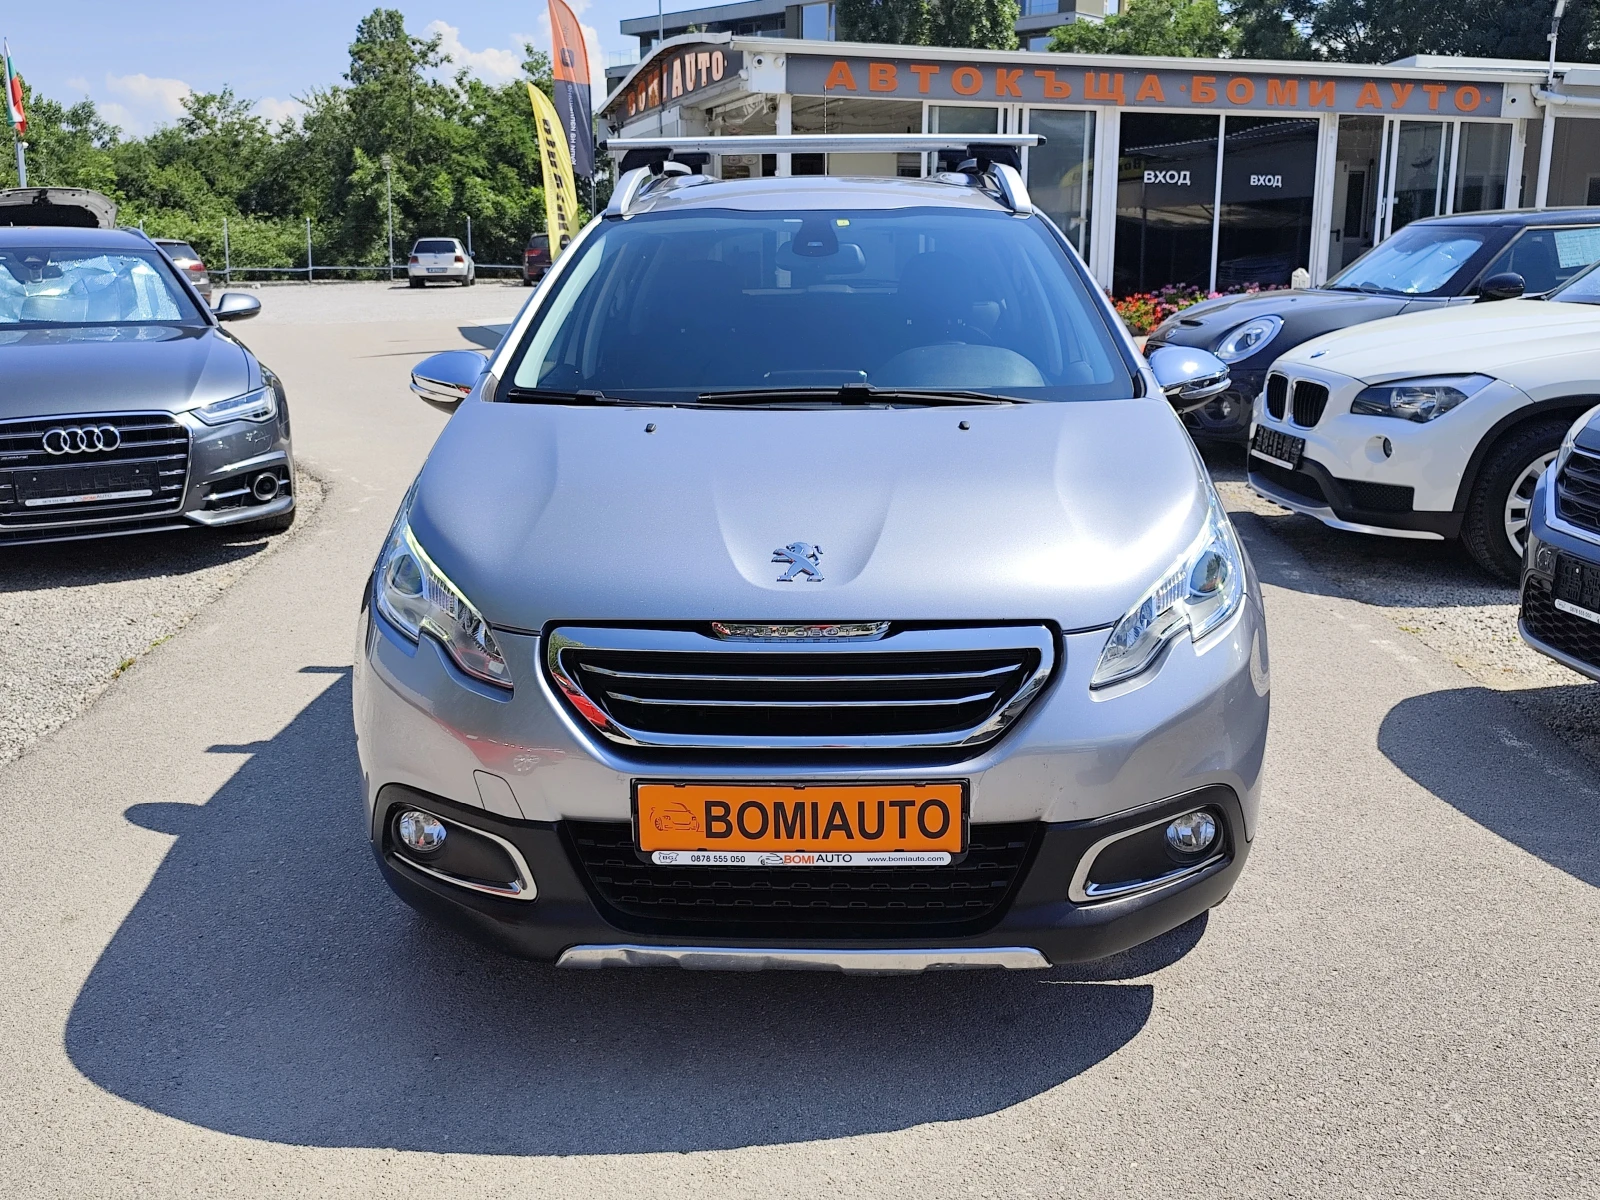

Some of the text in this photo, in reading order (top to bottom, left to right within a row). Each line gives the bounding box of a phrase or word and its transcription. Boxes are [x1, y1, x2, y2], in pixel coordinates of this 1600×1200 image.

[825, 61, 1481, 112] АВТОКЪЩА БОМИ АУТО
[1143, 170, 1191, 186] ВХОД
[1250, 175, 1282, 188] ВХОД
[704, 799, 951, 840] BOMIAUTO
[690, 855, 746, 863] 0878 555 050
